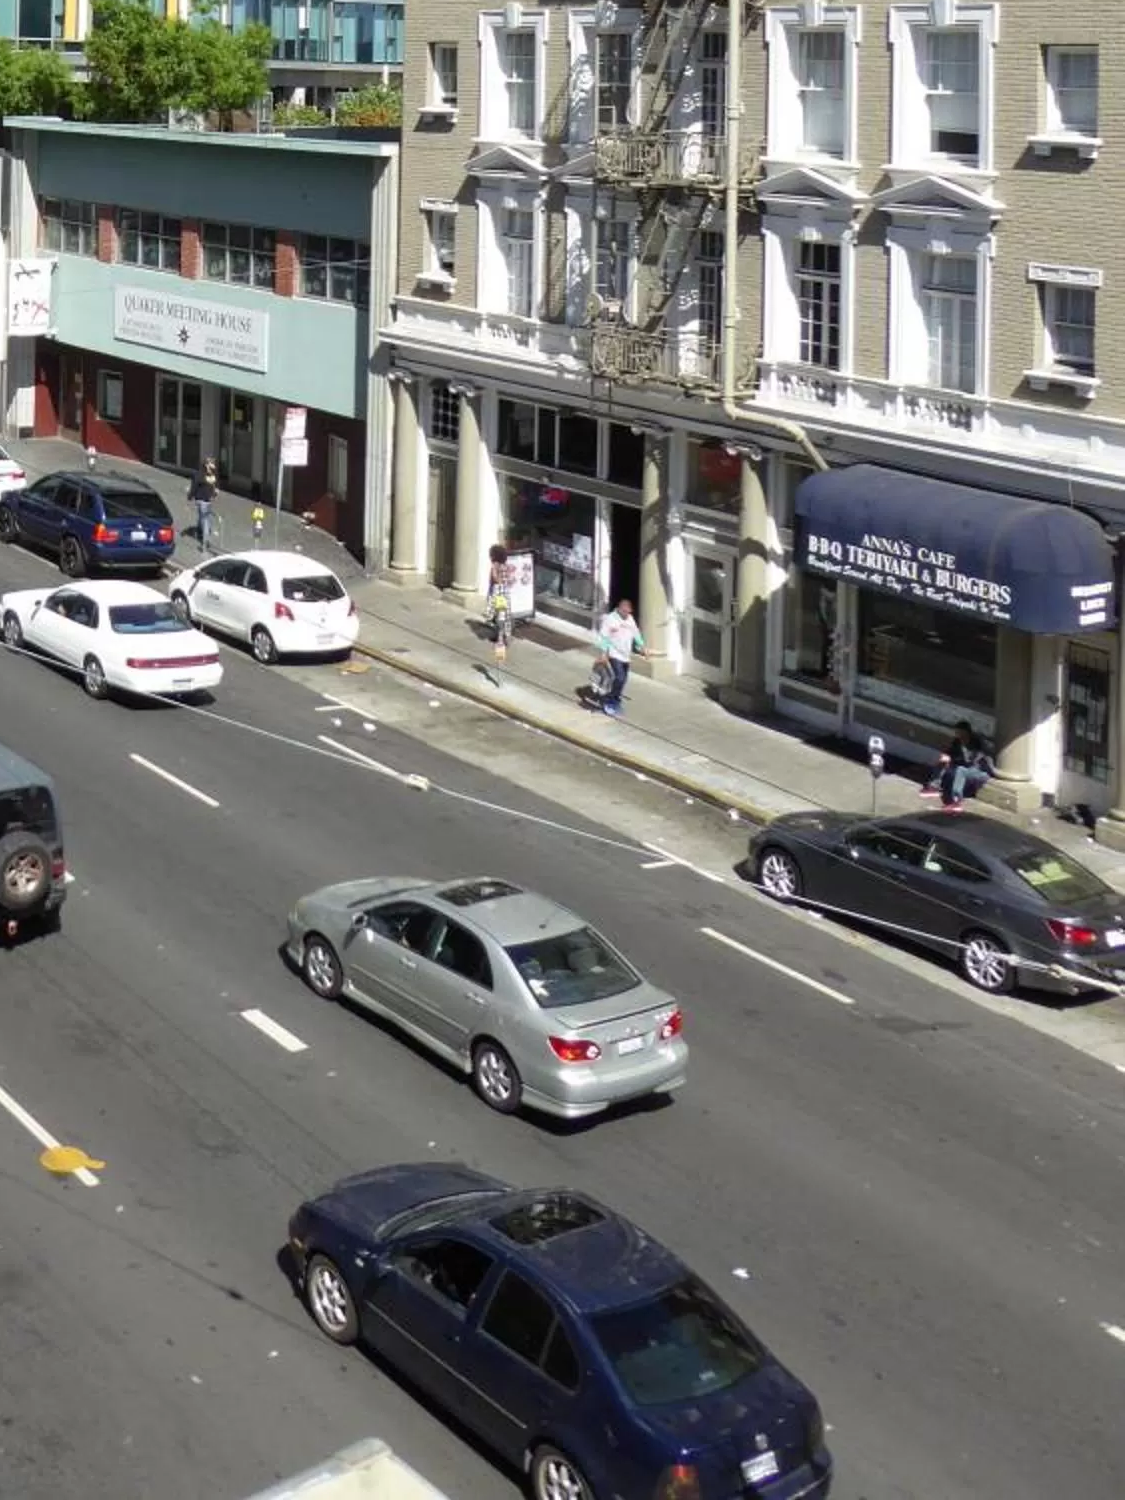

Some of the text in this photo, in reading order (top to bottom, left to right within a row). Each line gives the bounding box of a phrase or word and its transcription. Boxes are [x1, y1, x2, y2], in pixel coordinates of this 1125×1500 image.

[124, 293, 252, 334] QUAKER MEETING HOUSE
[860, 533, 956, 570] ANNA'S CAFE
[846, 544, 918, 581] TERIYAKI
[921, 569, 931, 583] &
[935, 568, 1011, 606] BURGERS
